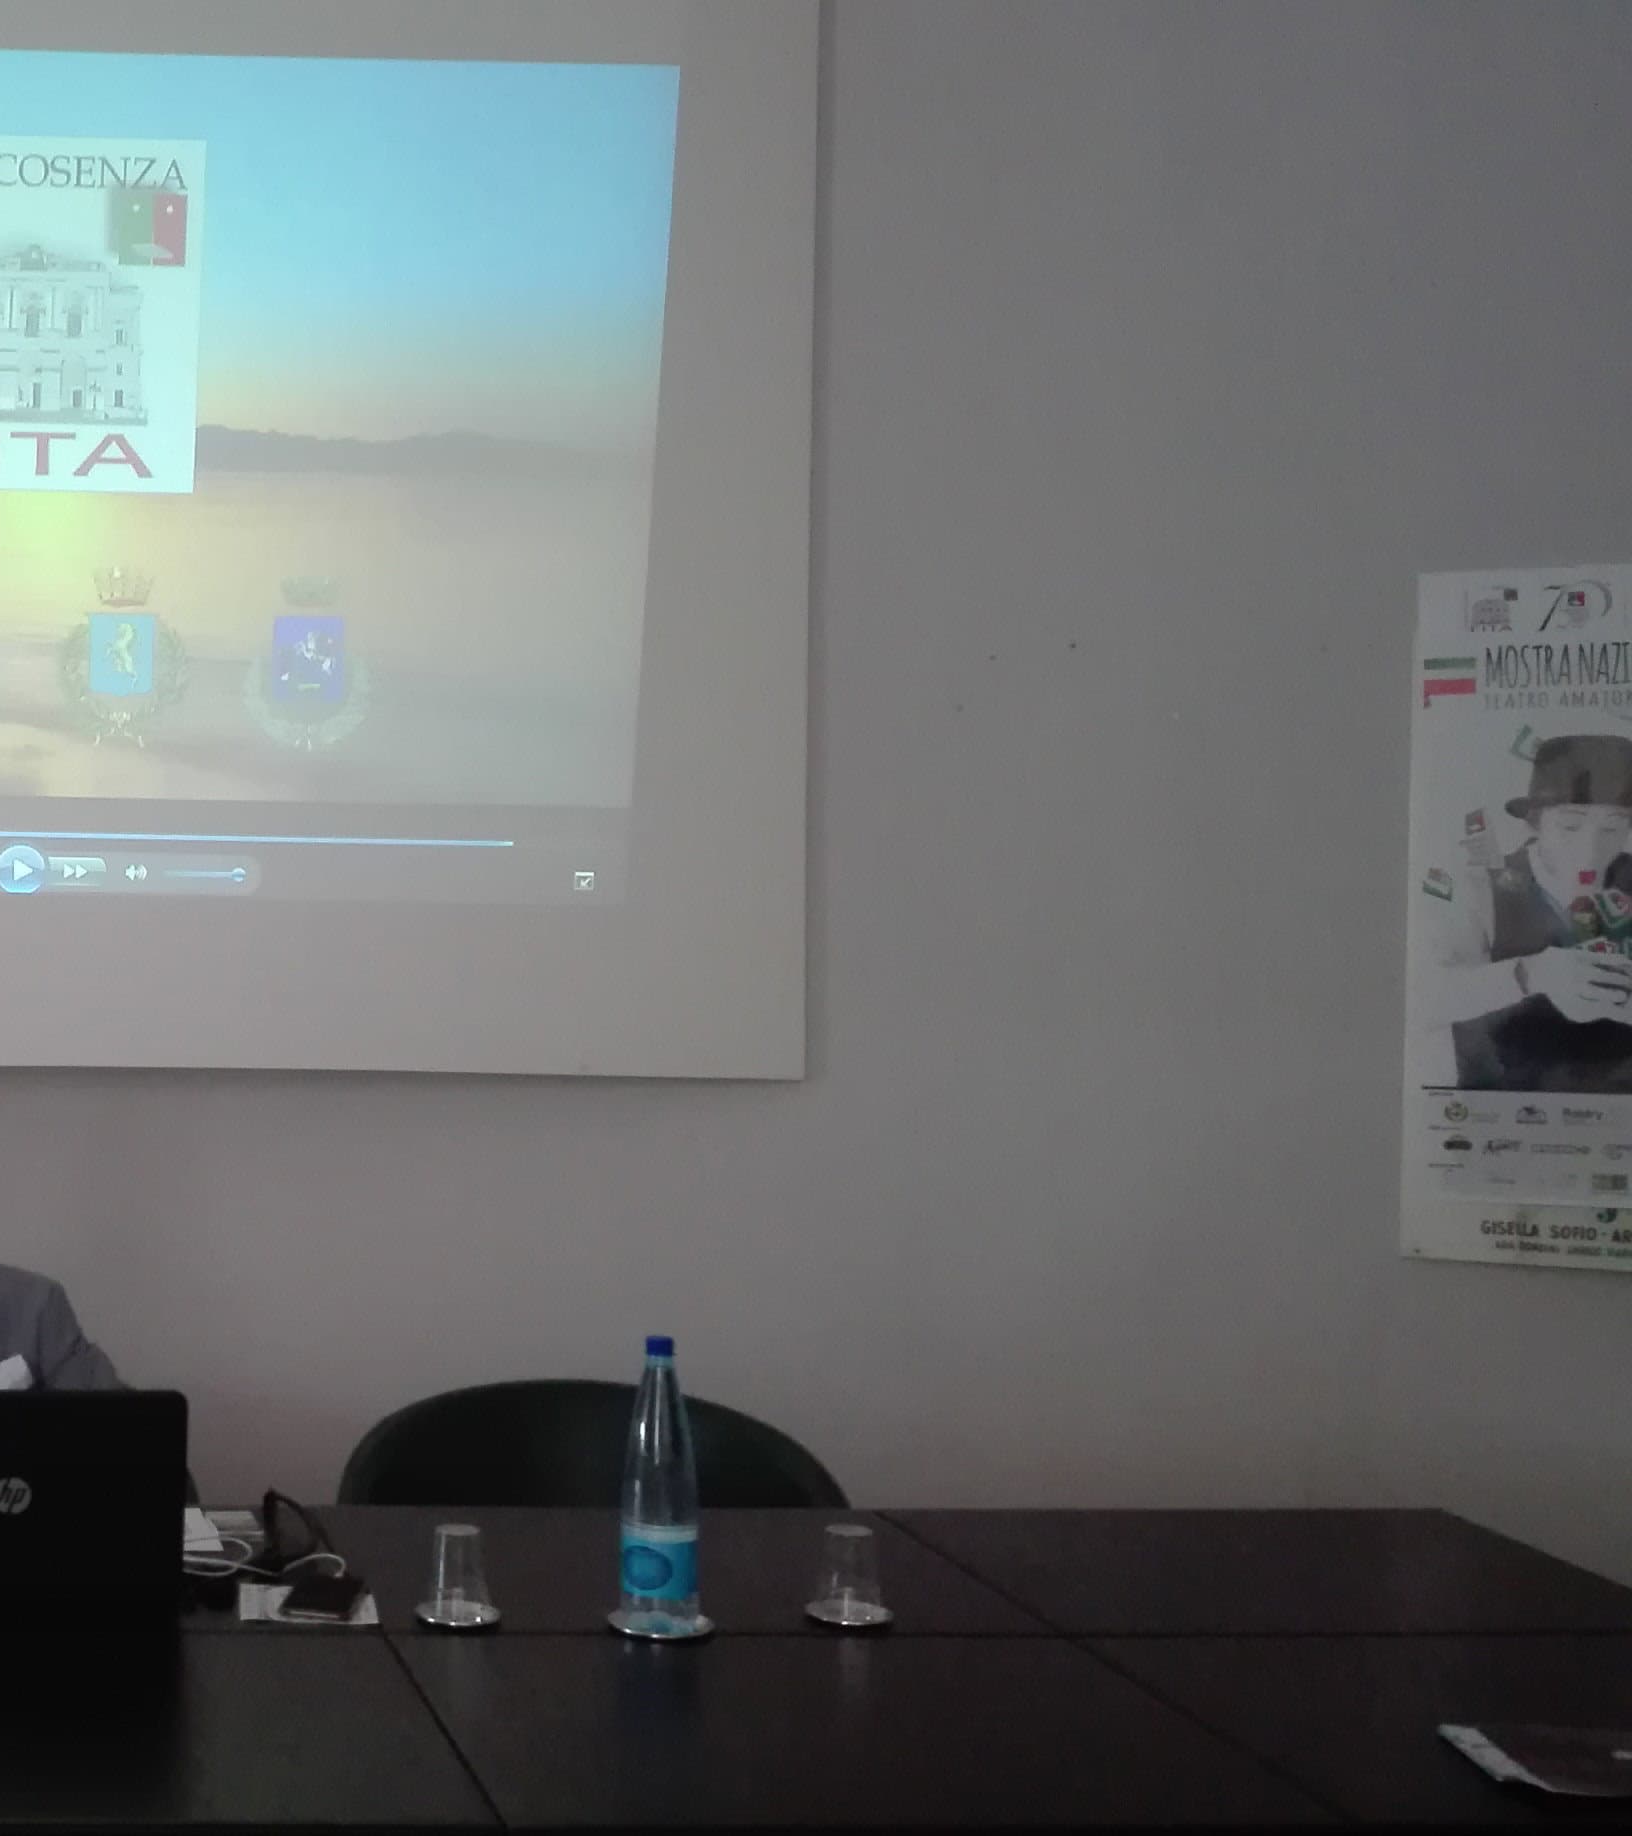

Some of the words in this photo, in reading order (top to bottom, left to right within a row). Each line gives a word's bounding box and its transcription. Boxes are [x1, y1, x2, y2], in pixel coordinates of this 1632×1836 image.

[1485, 644, 1572, 689] MOSTRA
[1578, 641, 1632, 686] NAZI
[1480, 1219, 1540, 1238] GISELLA
